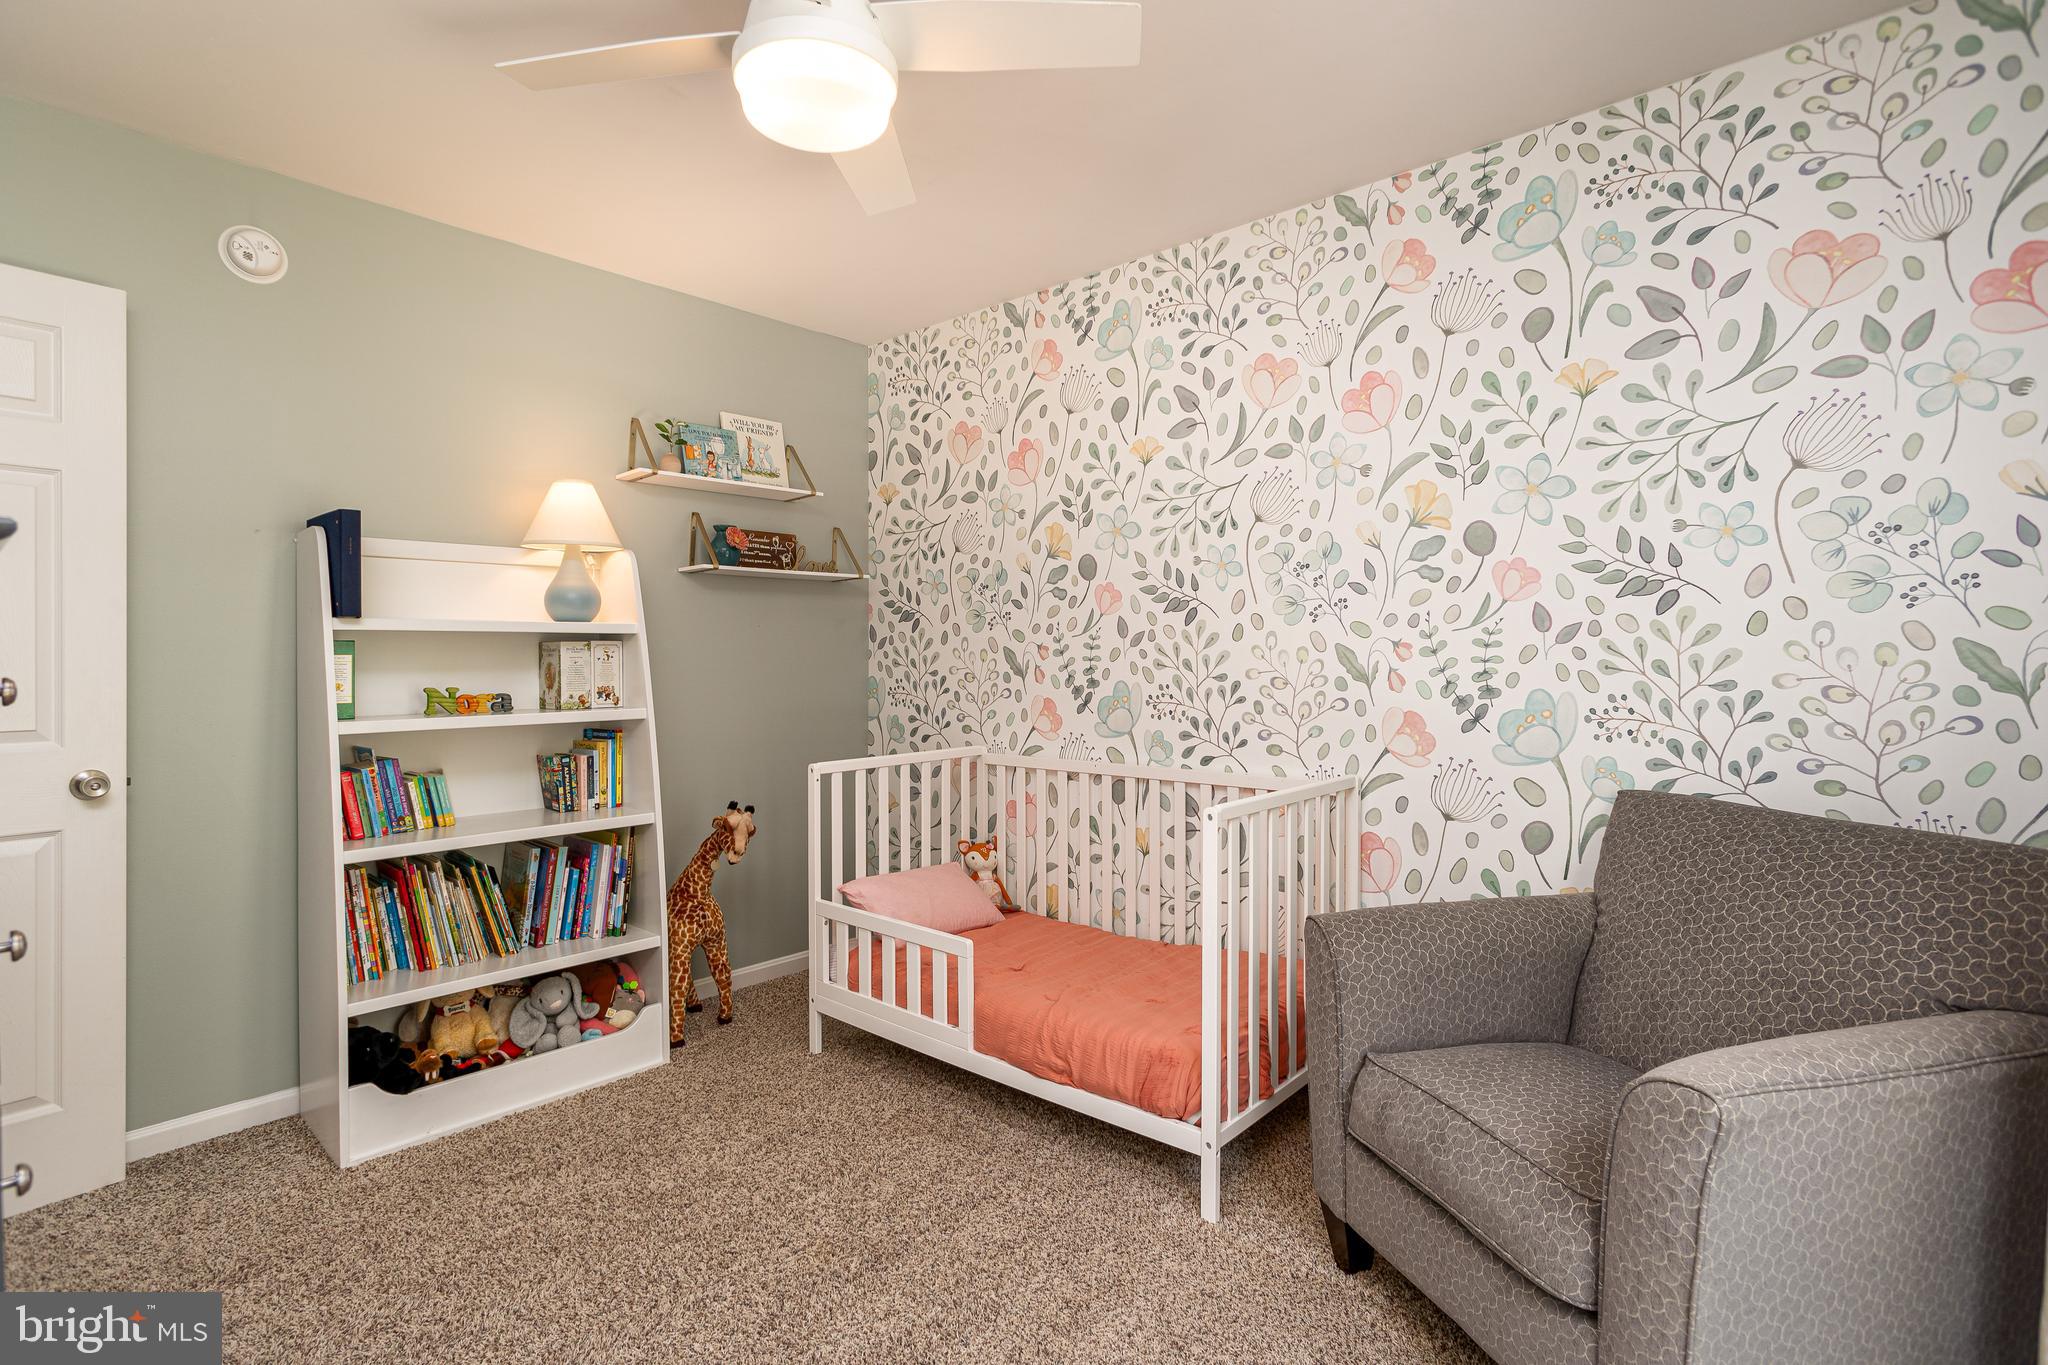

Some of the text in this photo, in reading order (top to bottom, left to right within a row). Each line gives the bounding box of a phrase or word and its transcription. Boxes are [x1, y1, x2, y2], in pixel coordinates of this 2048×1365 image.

[732, 418, 750, 427] WILL
[750, 421, 765, 430] YOU
[423, 687, 514, 716] Nora
